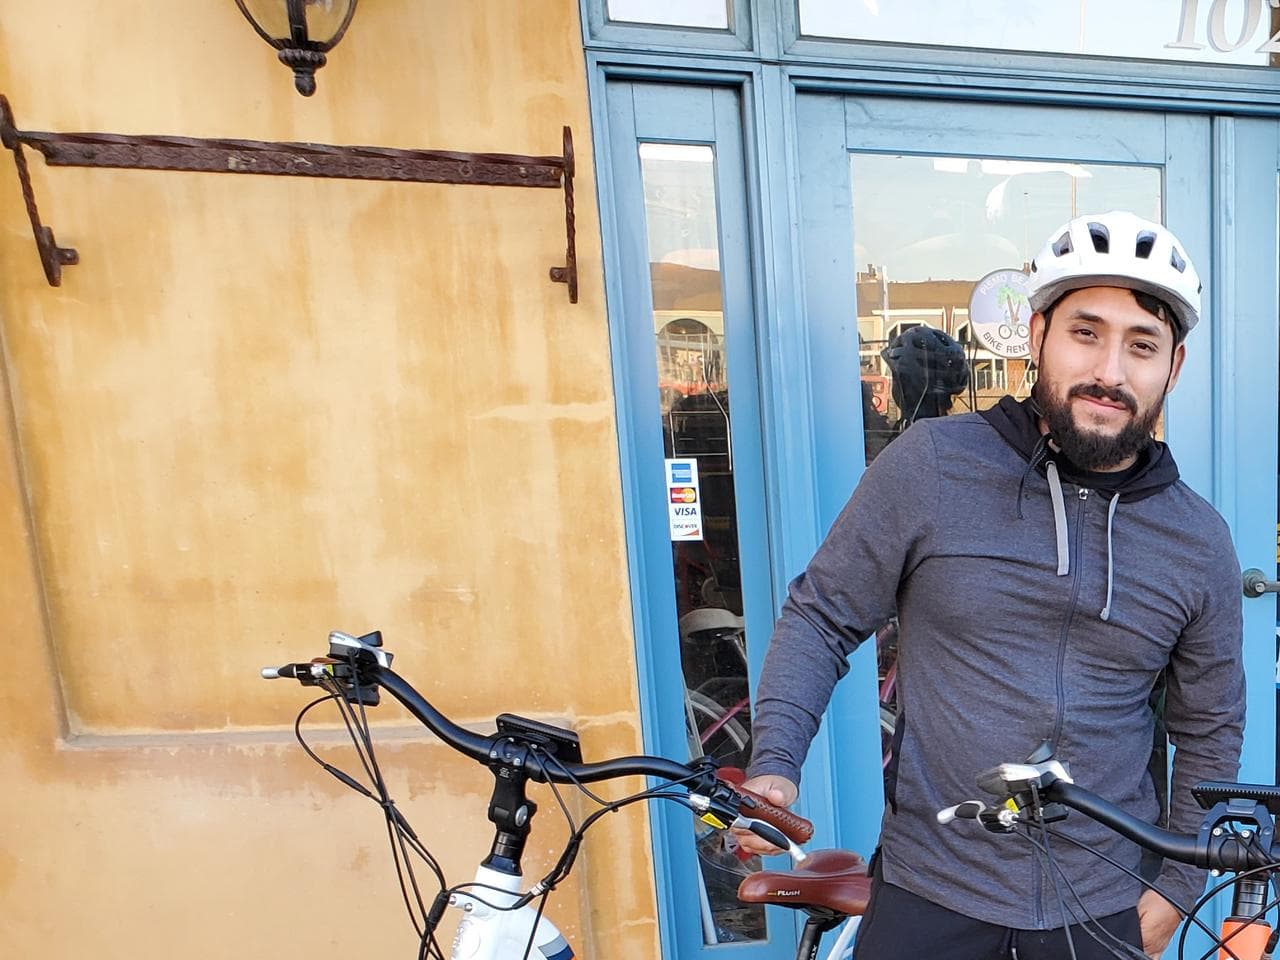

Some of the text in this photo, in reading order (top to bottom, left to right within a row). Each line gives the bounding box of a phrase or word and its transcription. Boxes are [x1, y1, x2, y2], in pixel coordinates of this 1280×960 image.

[983, 331, 1031, 354] BIKE RENT
[674, 507, 697, 516] VISA
